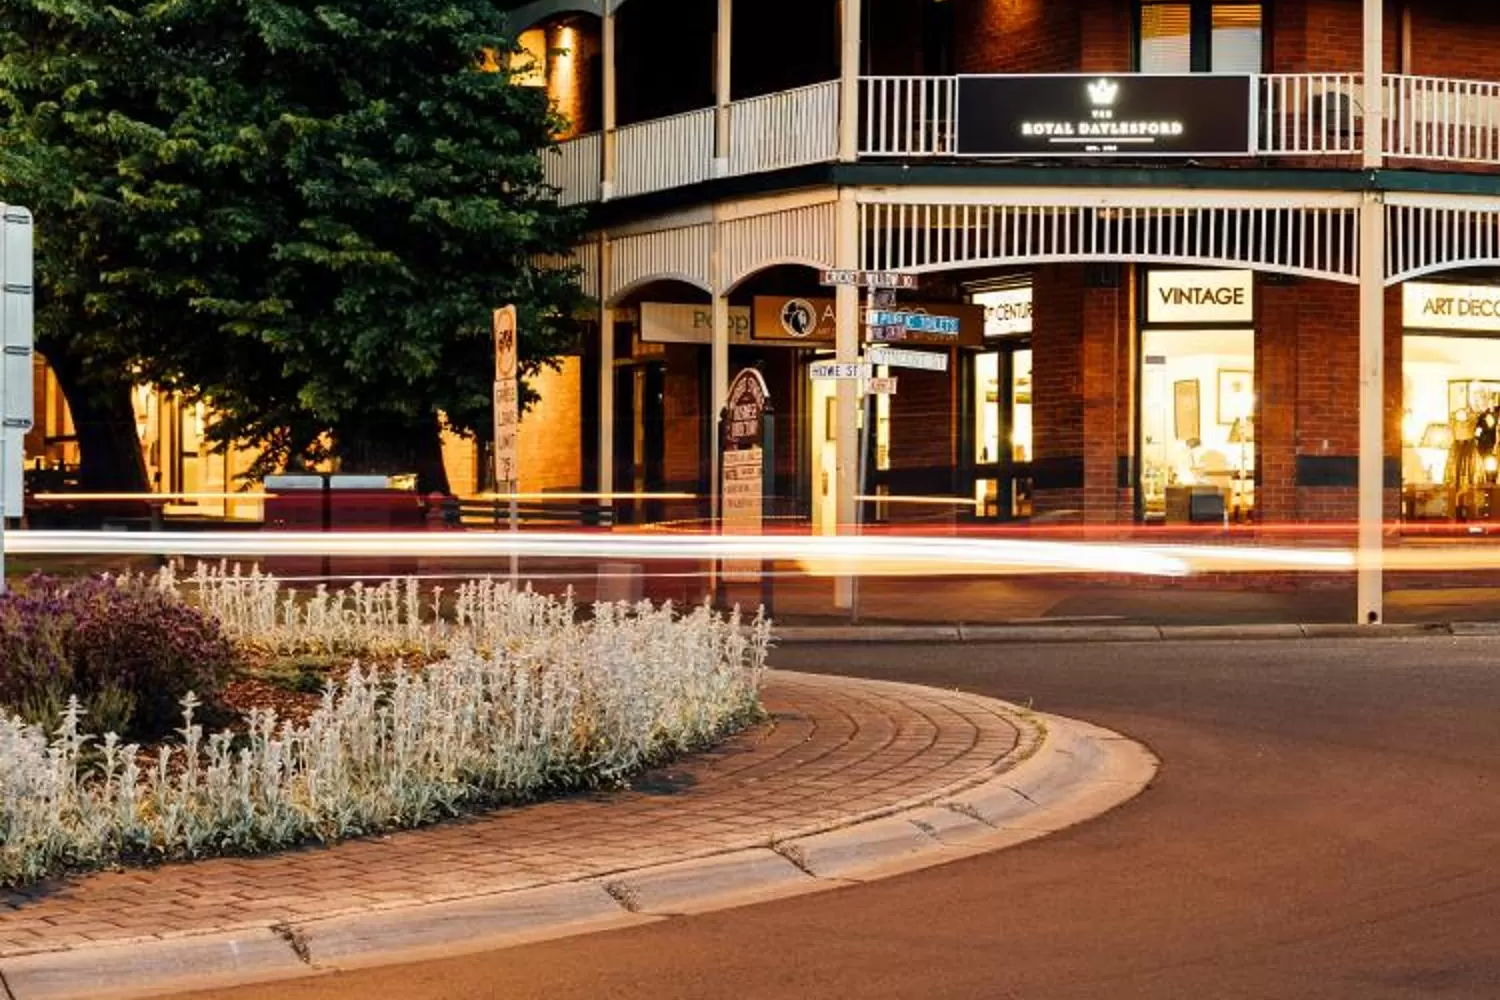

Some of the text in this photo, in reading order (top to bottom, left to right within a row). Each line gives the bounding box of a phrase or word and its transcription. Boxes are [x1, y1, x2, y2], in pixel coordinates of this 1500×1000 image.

[1021, 121, 1184, 136] ROYAL DAYLESFORD
[1158, 286, 1246, 306] VINTAGE
[1423, 296, 1455, 316] ART
[846, 364, 859, 378] ST
